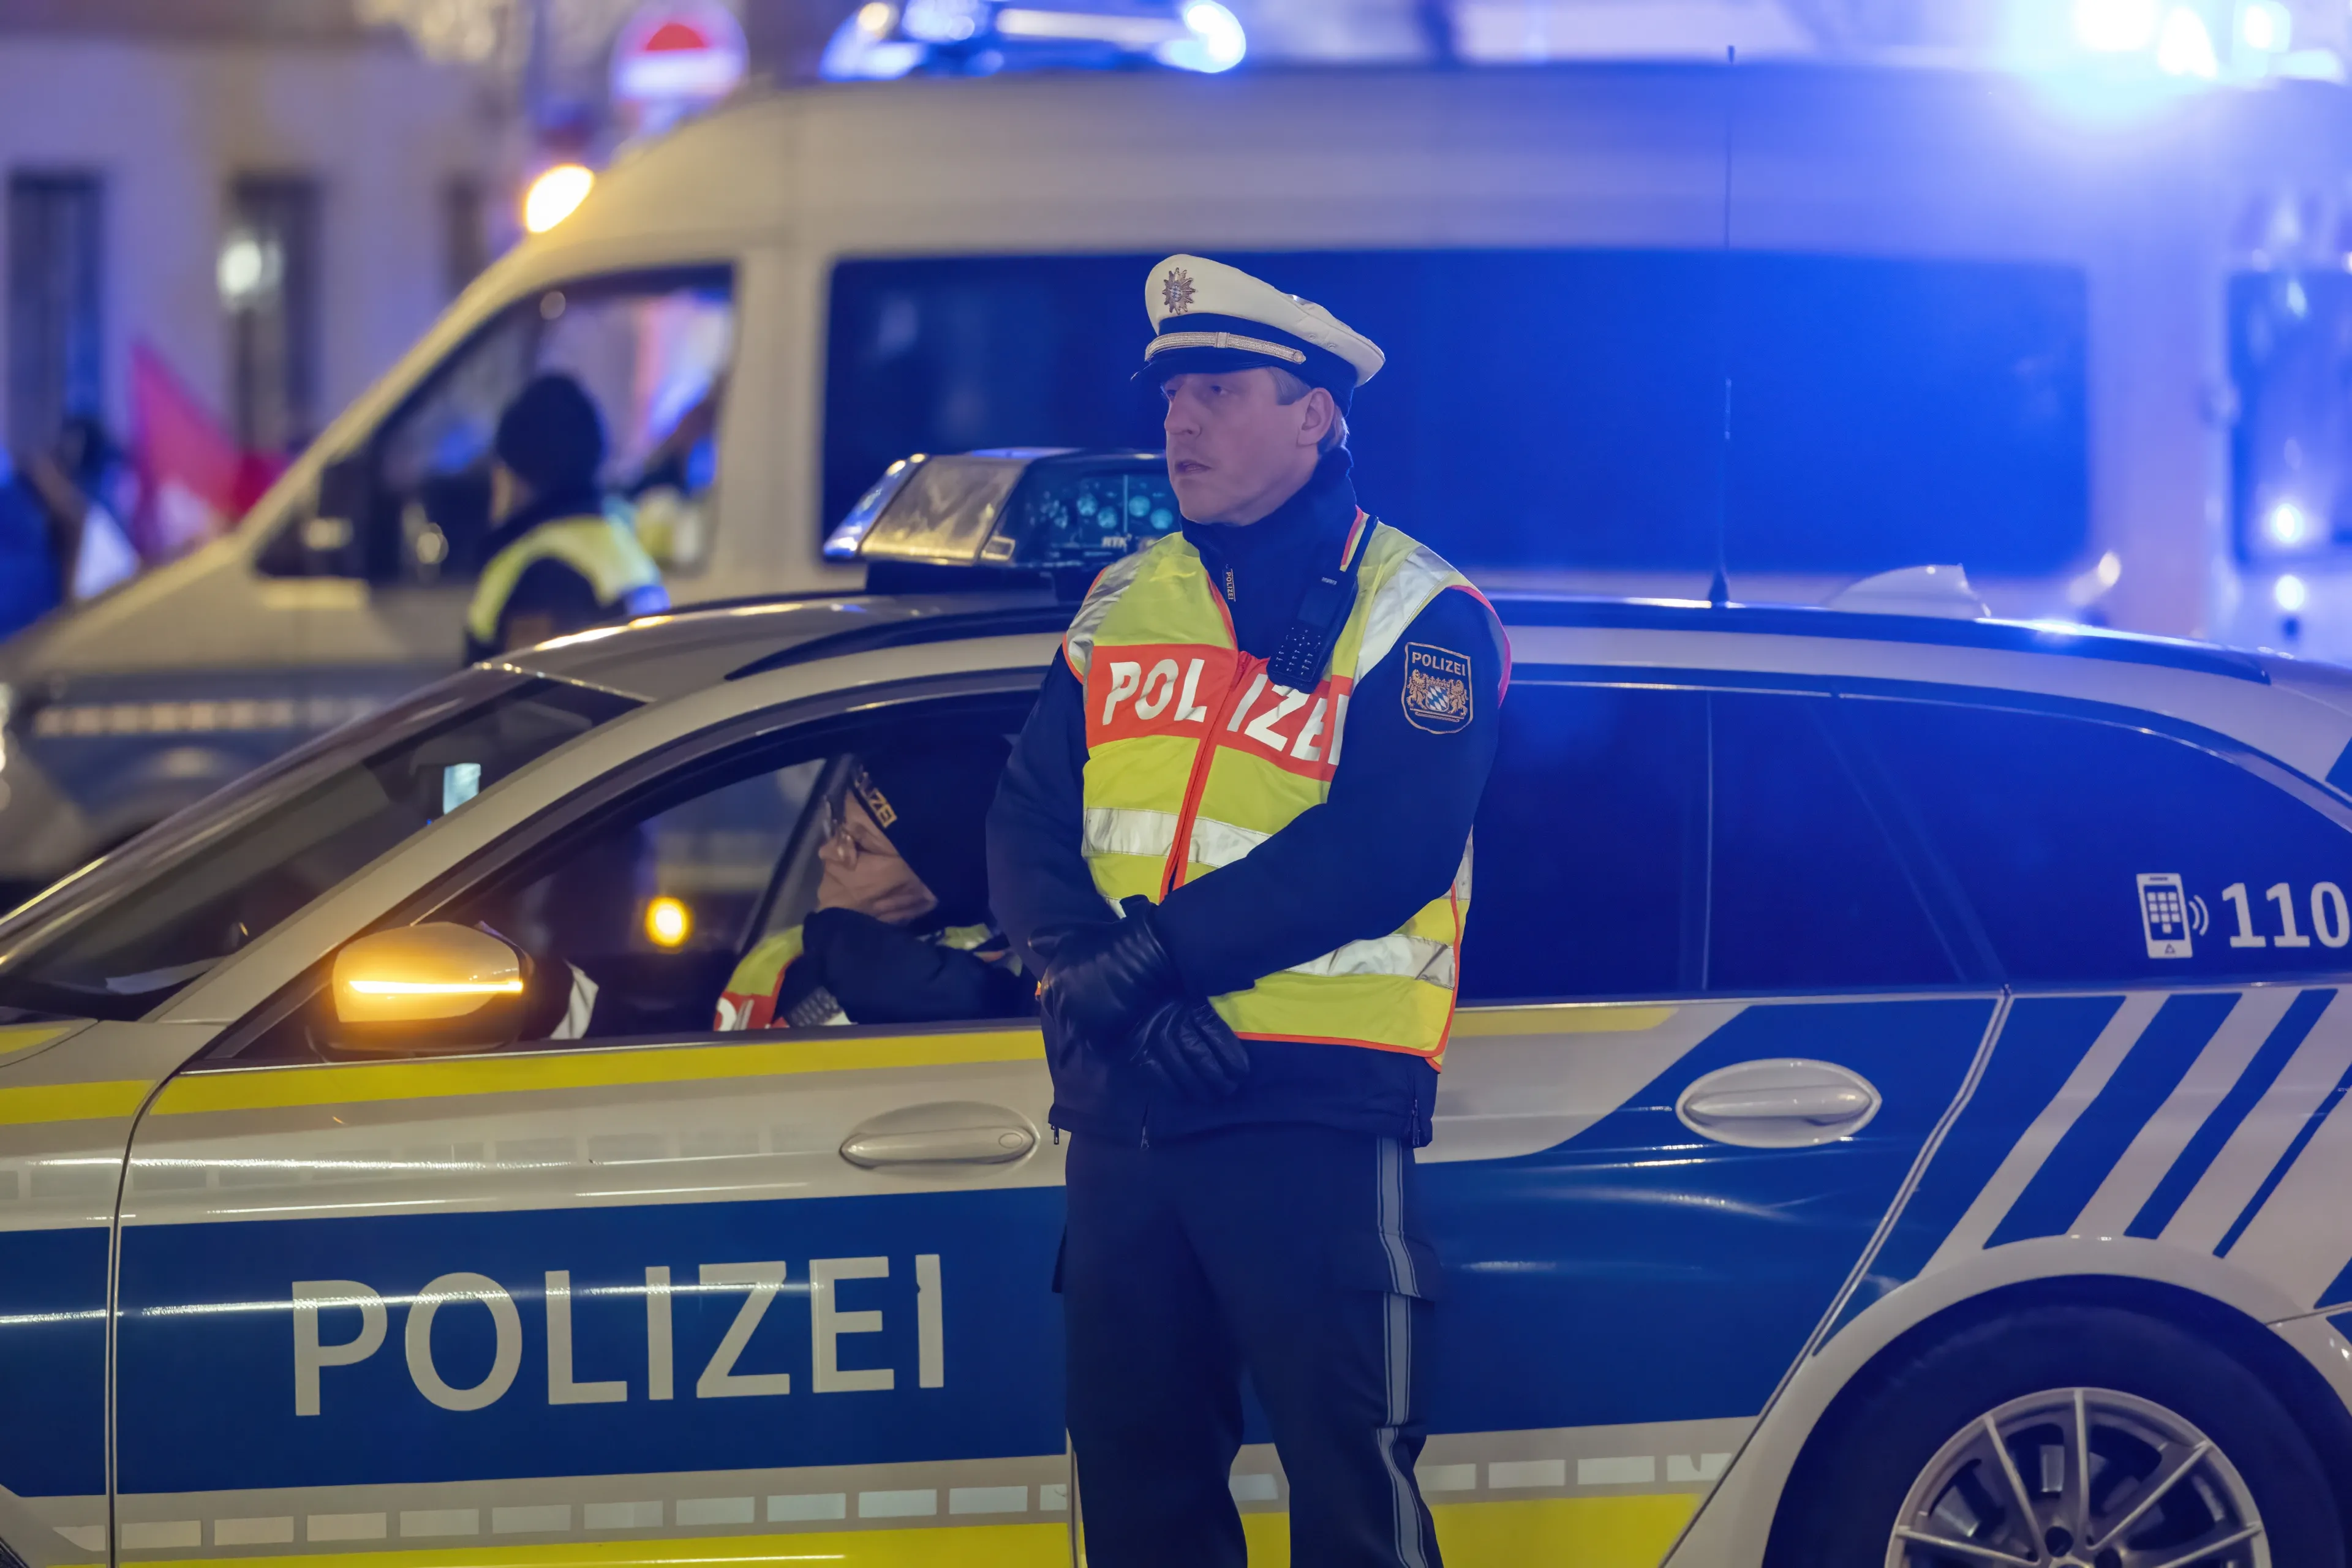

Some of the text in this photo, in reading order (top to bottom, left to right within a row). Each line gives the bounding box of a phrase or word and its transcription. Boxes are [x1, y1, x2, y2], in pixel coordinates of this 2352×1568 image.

[1226, 571, 1234, 600] POLIZEI
[1412, 651, 1466, 676] POLIZEI
[2222, 881, 2351, 949] 110
[292, 1253, 944, 1417] POLIZEI
